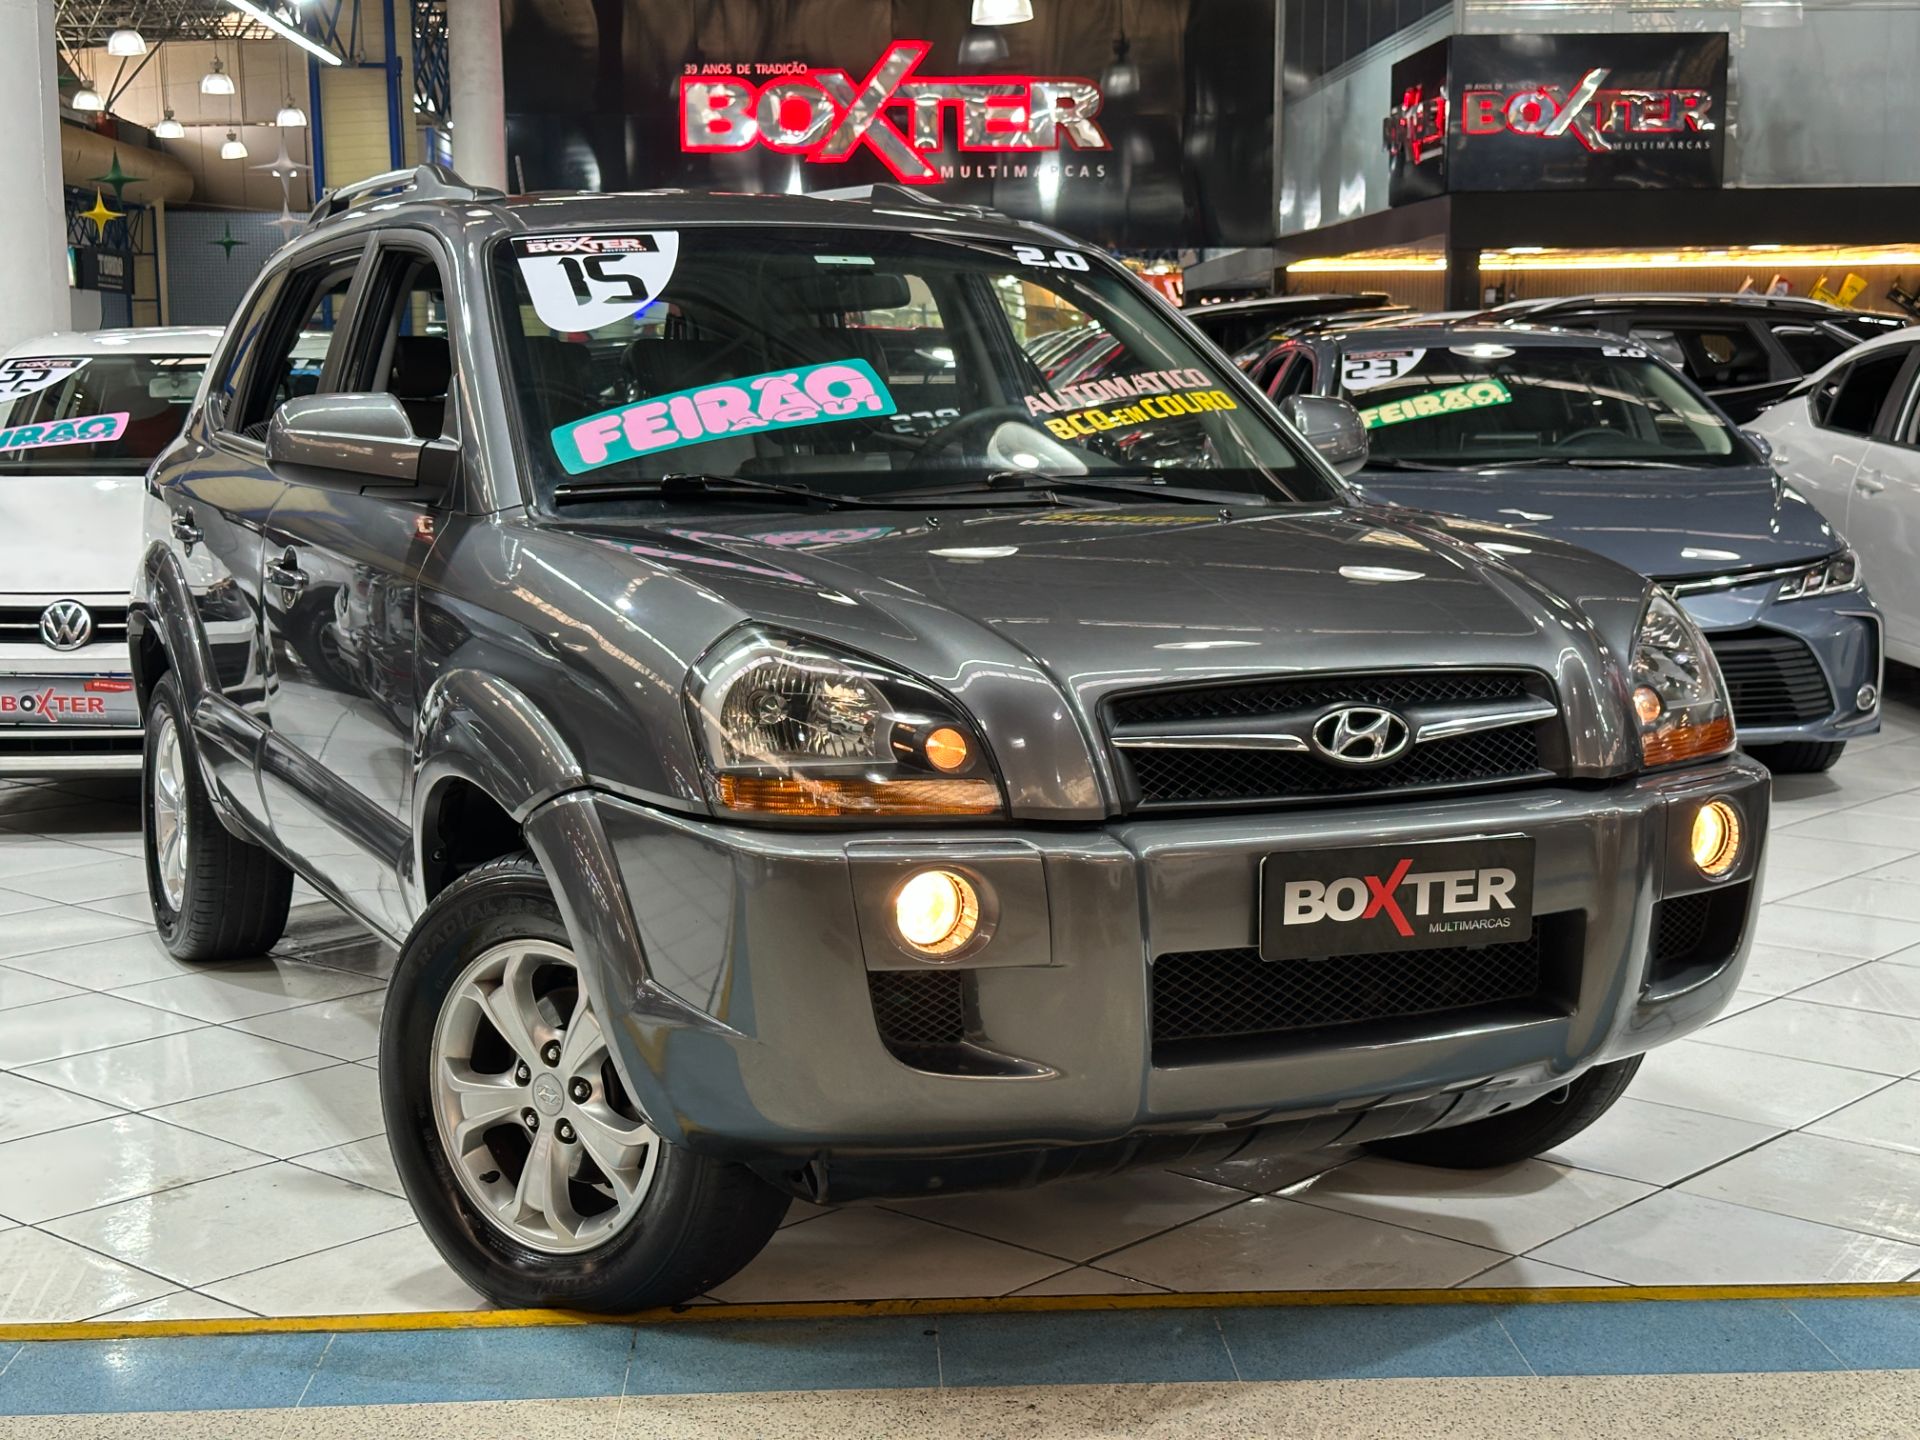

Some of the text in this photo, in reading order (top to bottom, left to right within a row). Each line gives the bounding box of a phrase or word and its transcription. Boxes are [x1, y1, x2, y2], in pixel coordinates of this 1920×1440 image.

[684, 61, 808, 76] 39 ANOS DE TRADIÇÃO
[680, 40, 1112, 184] BOXTER
[1462, 68, 1716, 153] BOXTER
[1613, 141, 1711, 150] MULTIMARCAS
[526, 236, 643, 253] BOXTER
[1012, 246, 1090, 271] 2.0
[557, 255, 649, 306] 15
[1346, 359, 1398, 379] 23
[573, 366, 876, 464] FEIRÃO
[1140, 390, 1237, 418] COURO
[1359, 383, 1502, 429] FEIRÃO
[1, 688, 105, 722] BOXTER
[1283, 859, 1516, 936] BOXTER
[1429, 917, 1511, 933] MULTIMARCAS
